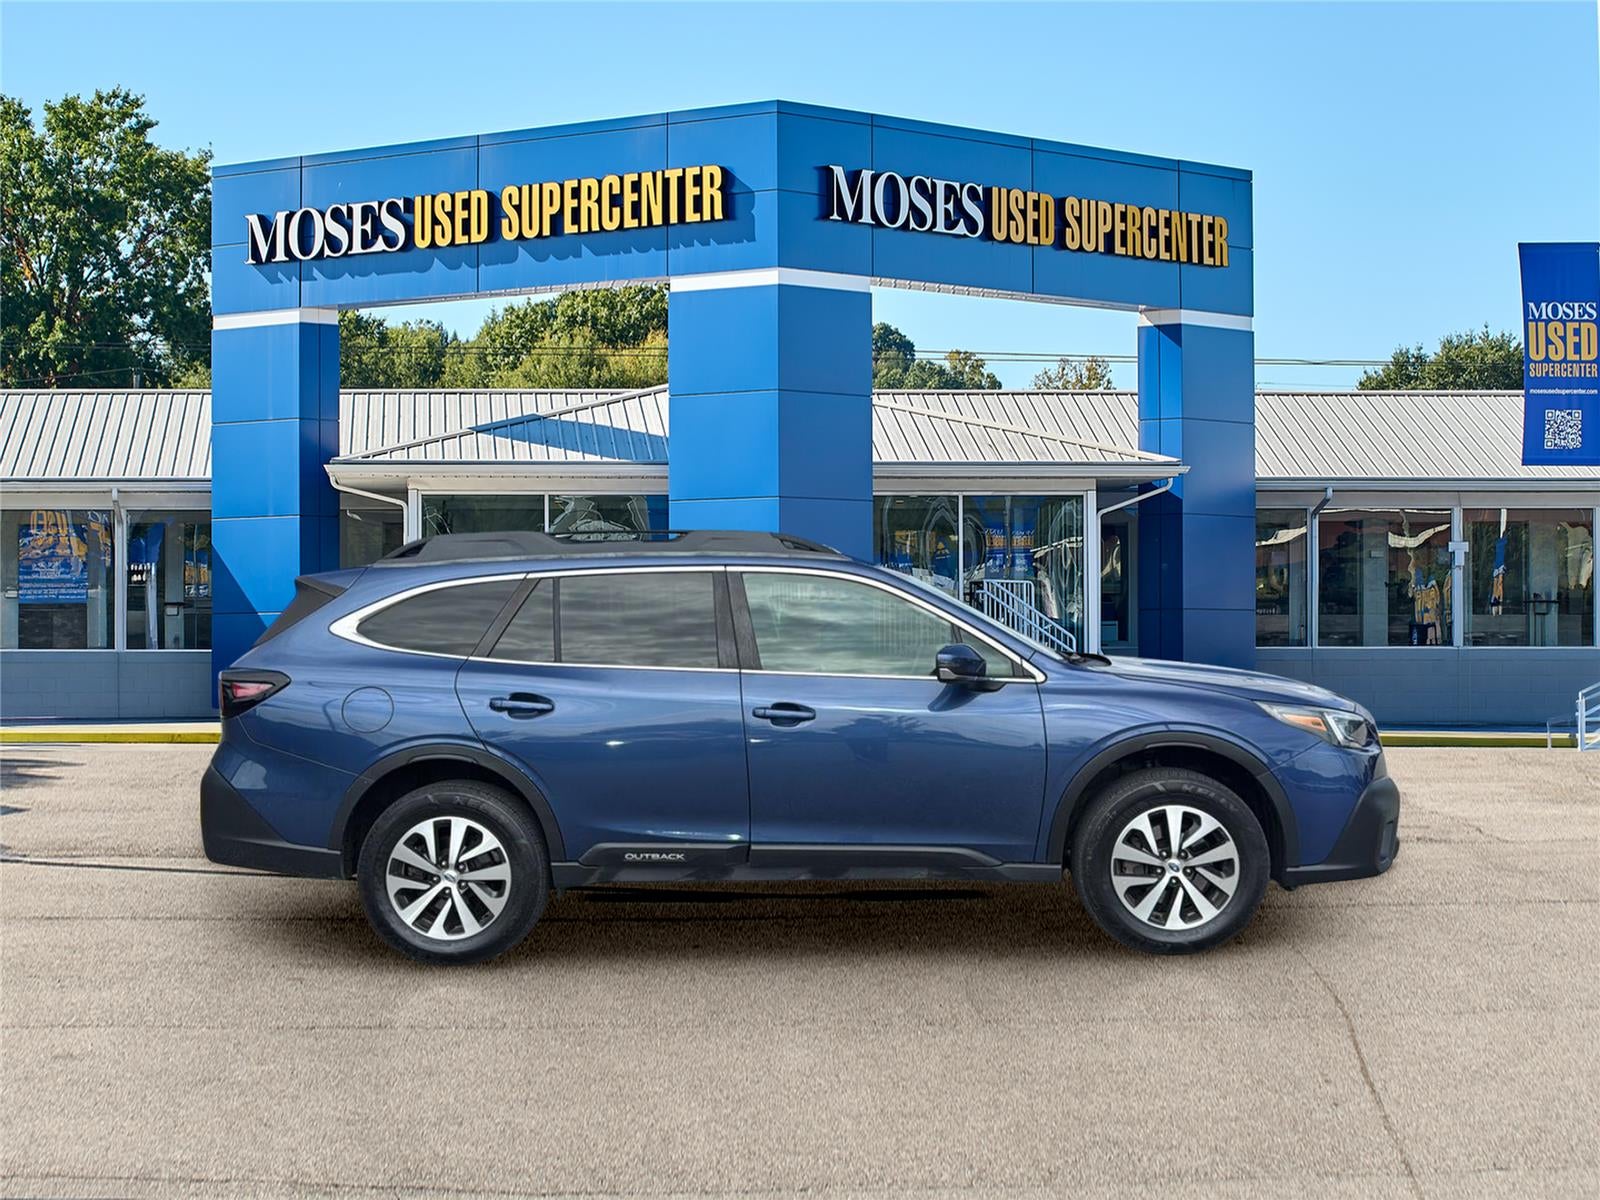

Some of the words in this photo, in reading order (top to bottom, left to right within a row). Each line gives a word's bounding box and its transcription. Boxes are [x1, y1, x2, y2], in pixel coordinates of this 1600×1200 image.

[244, 198, 406, 265] MOSES
[413, 189, 489, 249] USED
[501, 164, 724, 242] SUPERCENTER
[828, 164, 985, 238] MOSES
[991, 186, 1055, 246] USED
[1065, 195, 1229, 267] SUPERCENTER
[1527, 302, 1598, 320] MOSES
[1528, 321, 1598, 361] USED
[1529, 363, 1598, 378] SUPERCENTER
[1529, 388, 1598, 396] mosesusedsupercenter.com
[624, 853, 686, 861] OUTBACK
